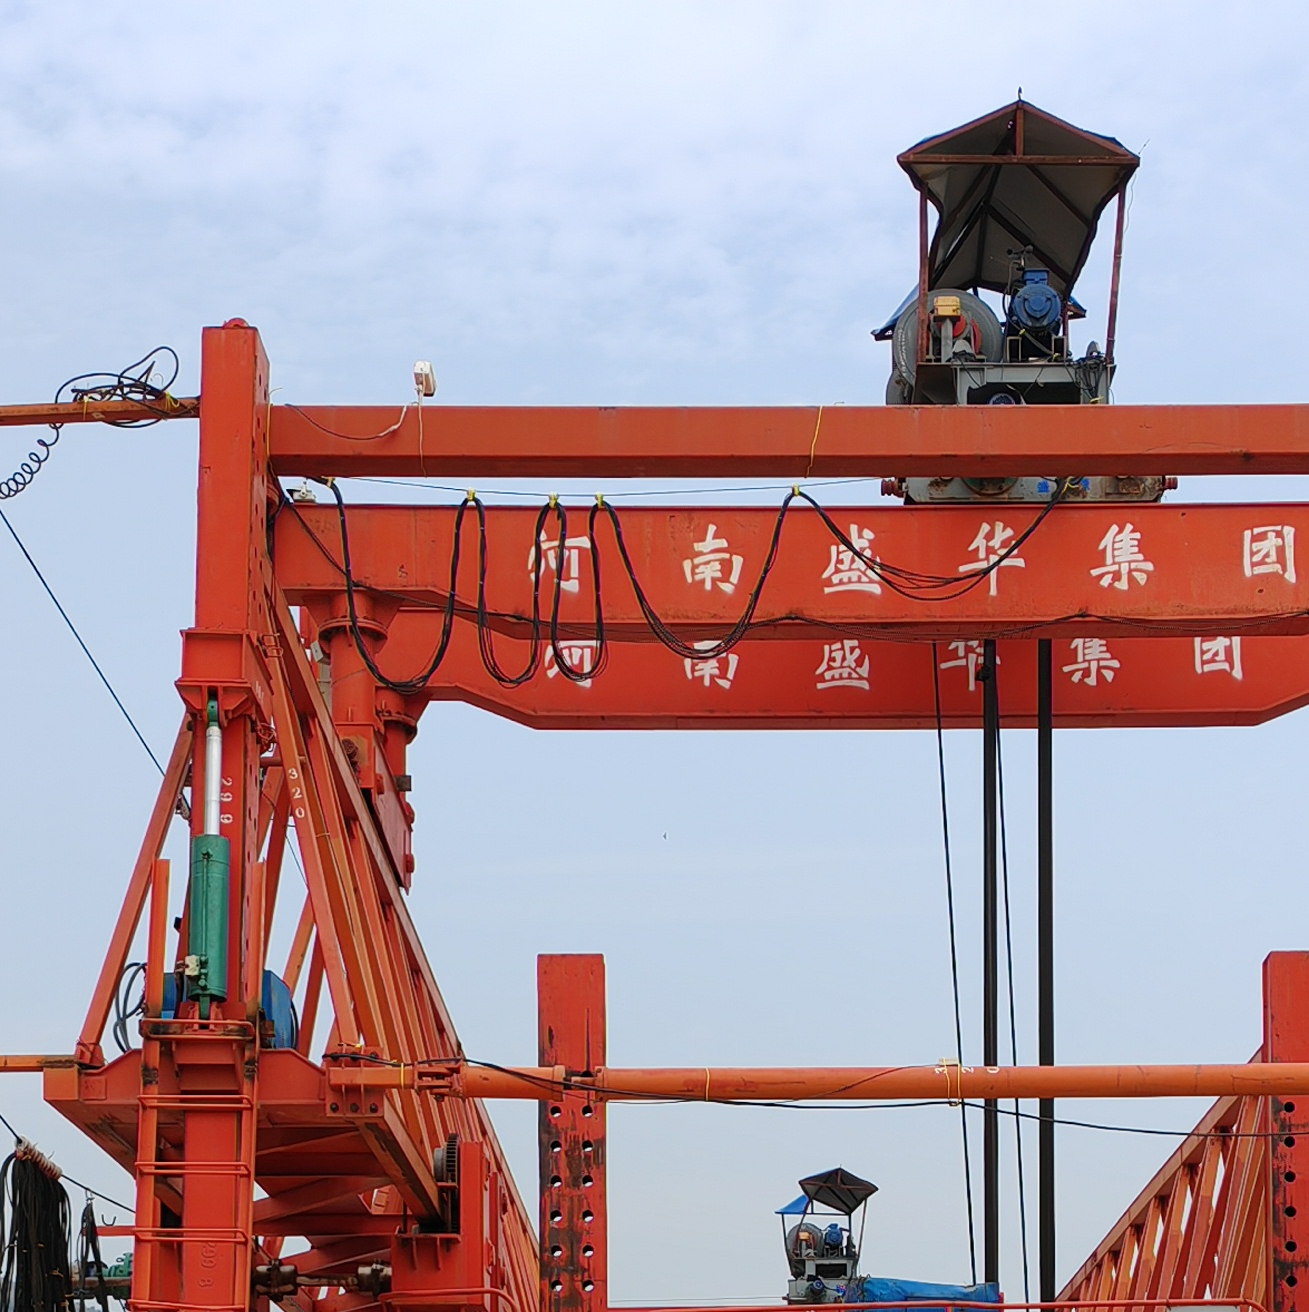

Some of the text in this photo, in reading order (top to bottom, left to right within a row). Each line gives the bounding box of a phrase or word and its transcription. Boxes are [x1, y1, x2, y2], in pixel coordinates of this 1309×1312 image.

[528, 521, 1296, 596] 河南盛华集团
[288, 767, 305, 819] 320
